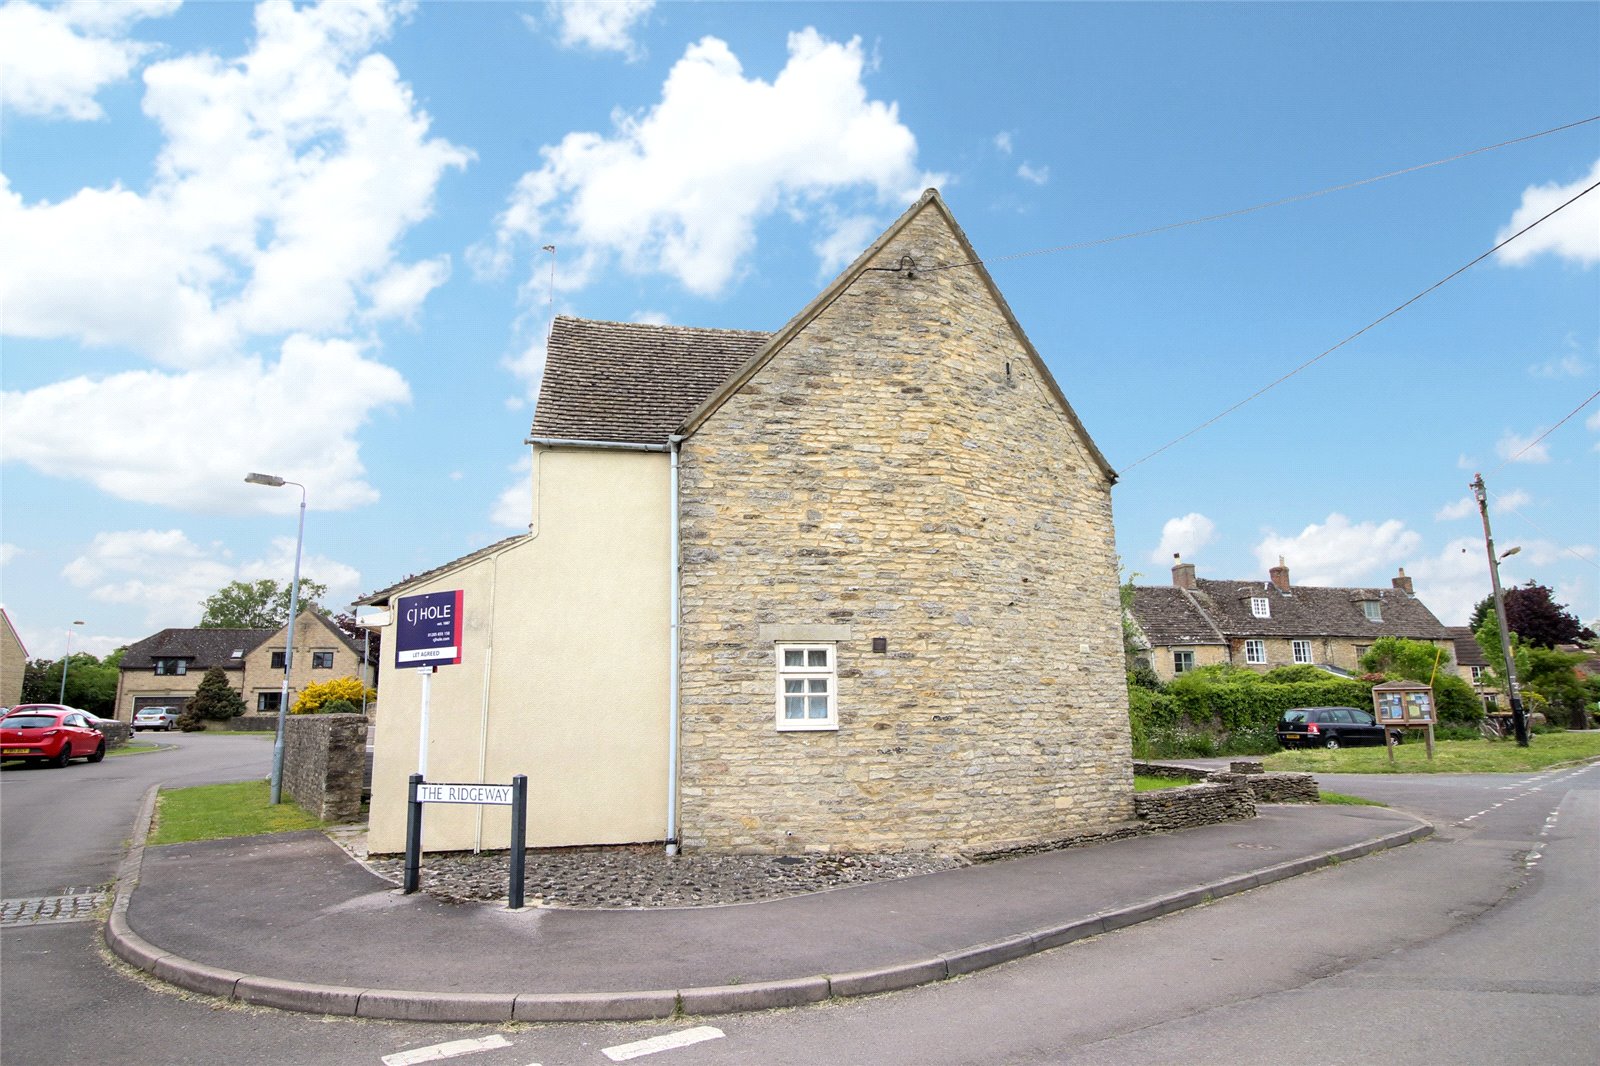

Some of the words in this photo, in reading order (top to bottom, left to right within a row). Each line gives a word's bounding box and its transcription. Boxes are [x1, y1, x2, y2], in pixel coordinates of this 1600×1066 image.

[420, 605, 451, 620] HOLE
[421, 787, 442, 800] THE
[449, 787, 510, 801] RIDGEWAY
